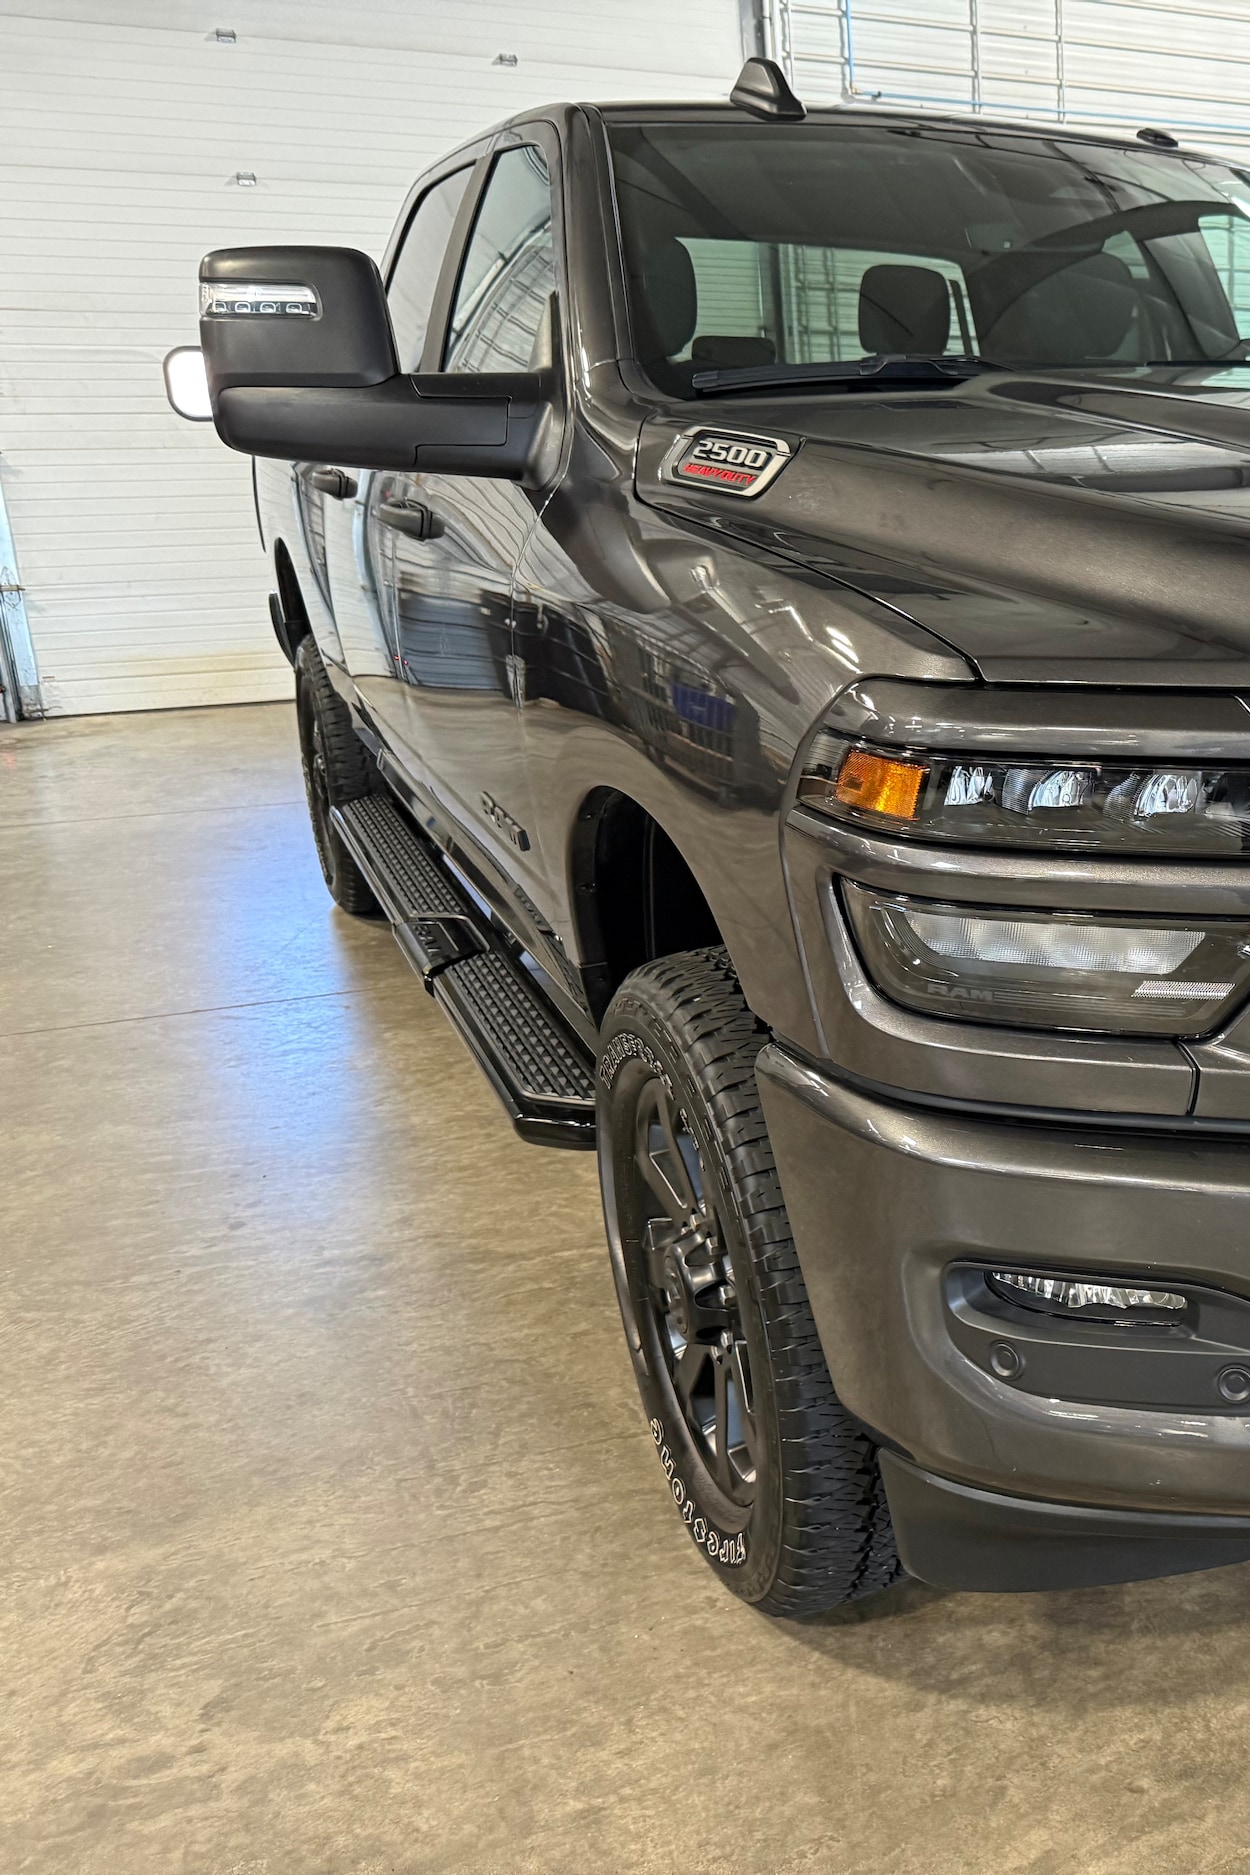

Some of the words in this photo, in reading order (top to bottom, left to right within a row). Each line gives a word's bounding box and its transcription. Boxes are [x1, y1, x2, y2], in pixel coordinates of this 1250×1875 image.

[692, 440, 768, 468] 2500
[683, 463, 722, 479] HEAVY
[720, 469, 757, 486] DUTY
[927, 983, 994, 1001] RAM
